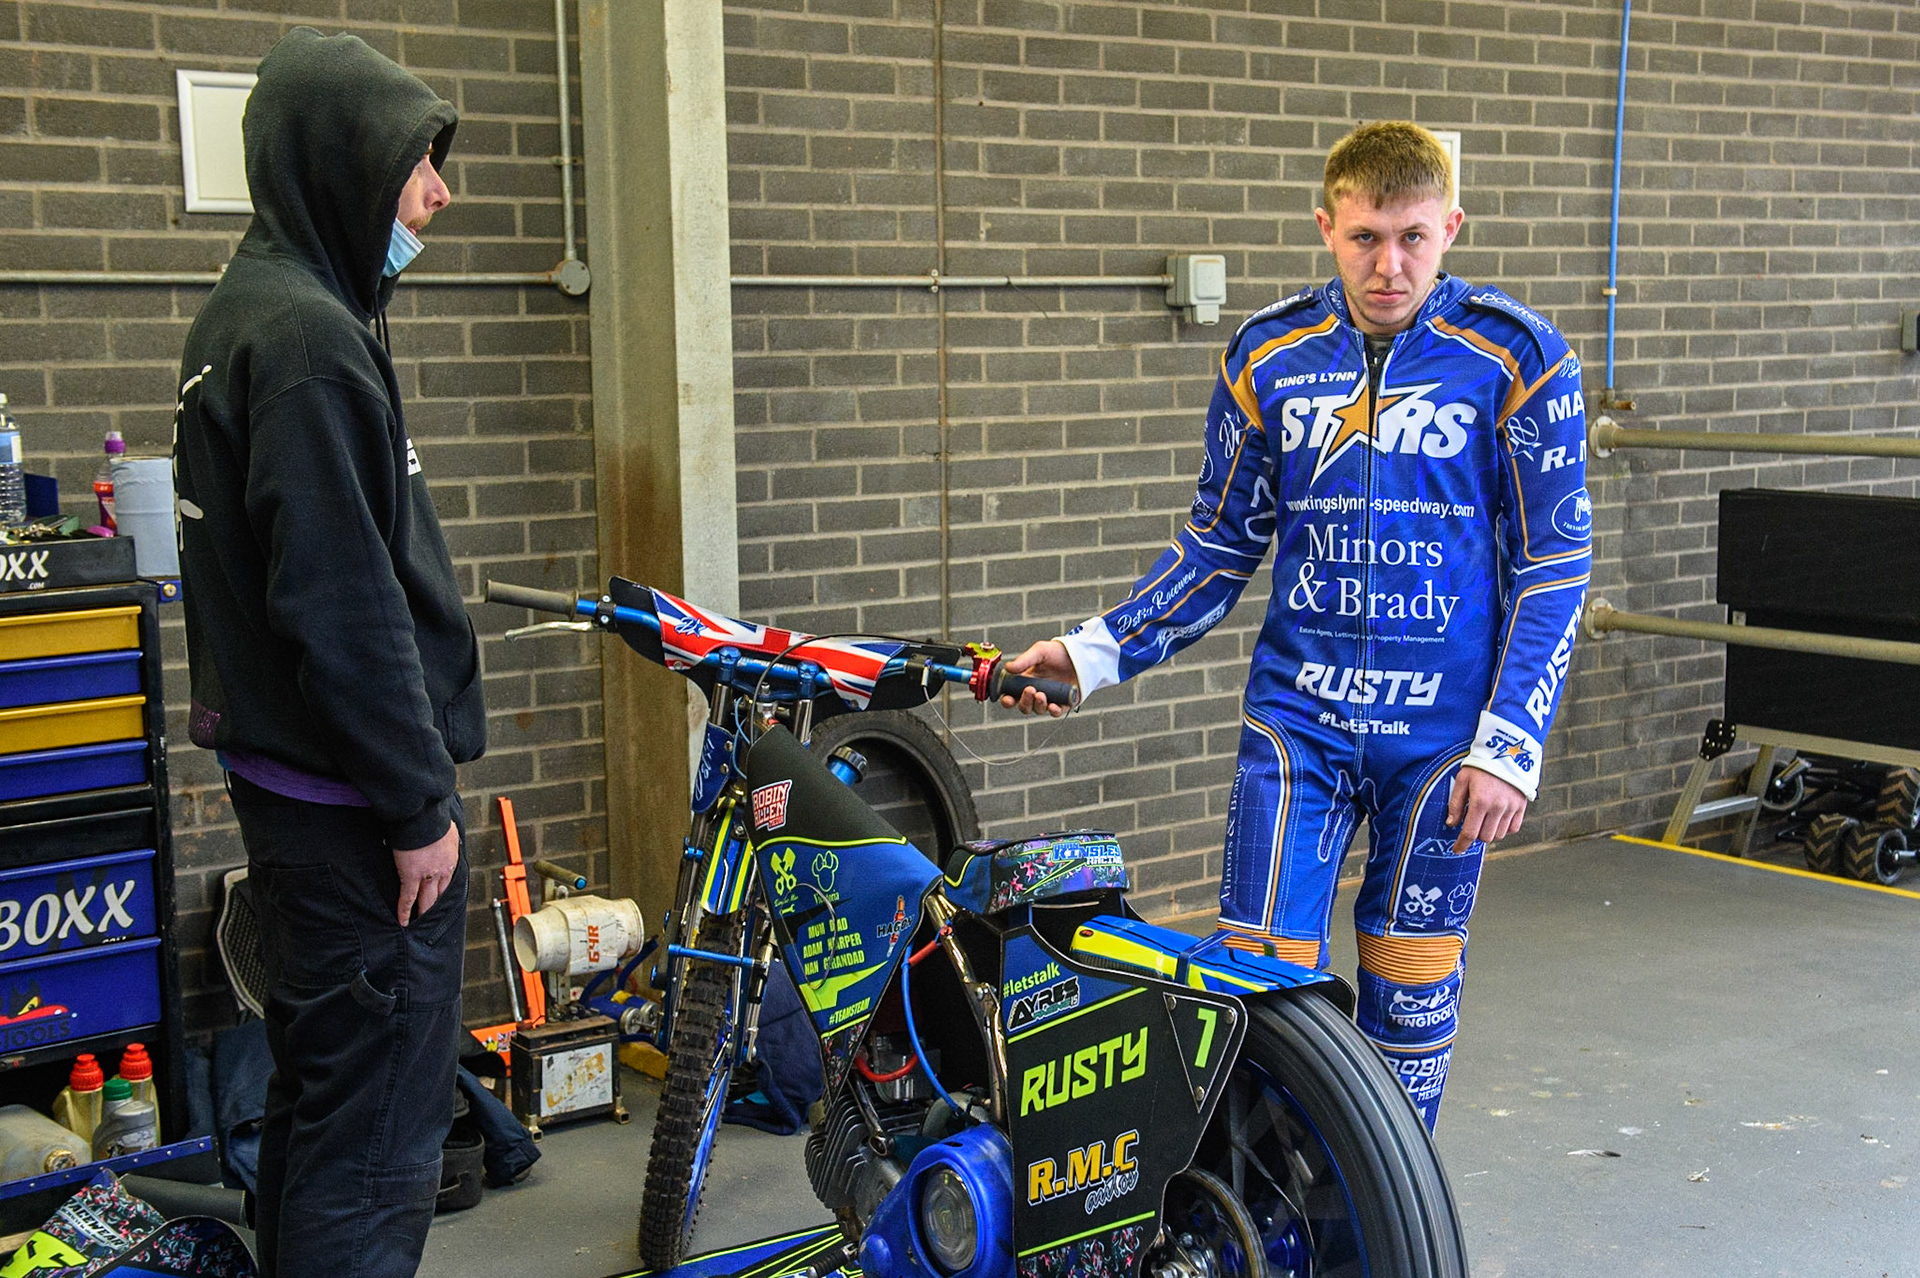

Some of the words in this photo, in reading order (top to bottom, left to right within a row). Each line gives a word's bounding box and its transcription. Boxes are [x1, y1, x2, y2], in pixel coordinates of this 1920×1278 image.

[1274, 373, 1317, 390] KING'S
[1319, 371, 1358, 383] LYNN
[1304, 523, 1444, 567] Minors
[1288, 562, 1327, 613] &
[1336, 576, 1460, 633] Brady
[1403, 635, 1445, 643] Management
[1295, 661, 1444, 706] RUSTY
[803, 941, 823, 959] ADAM
[1003, 962, 1061, 998] #letstalk
[1020, 1026, 1149, 1117] RUSTY
[1028, 1129, 1139, 1206] R.M.C
